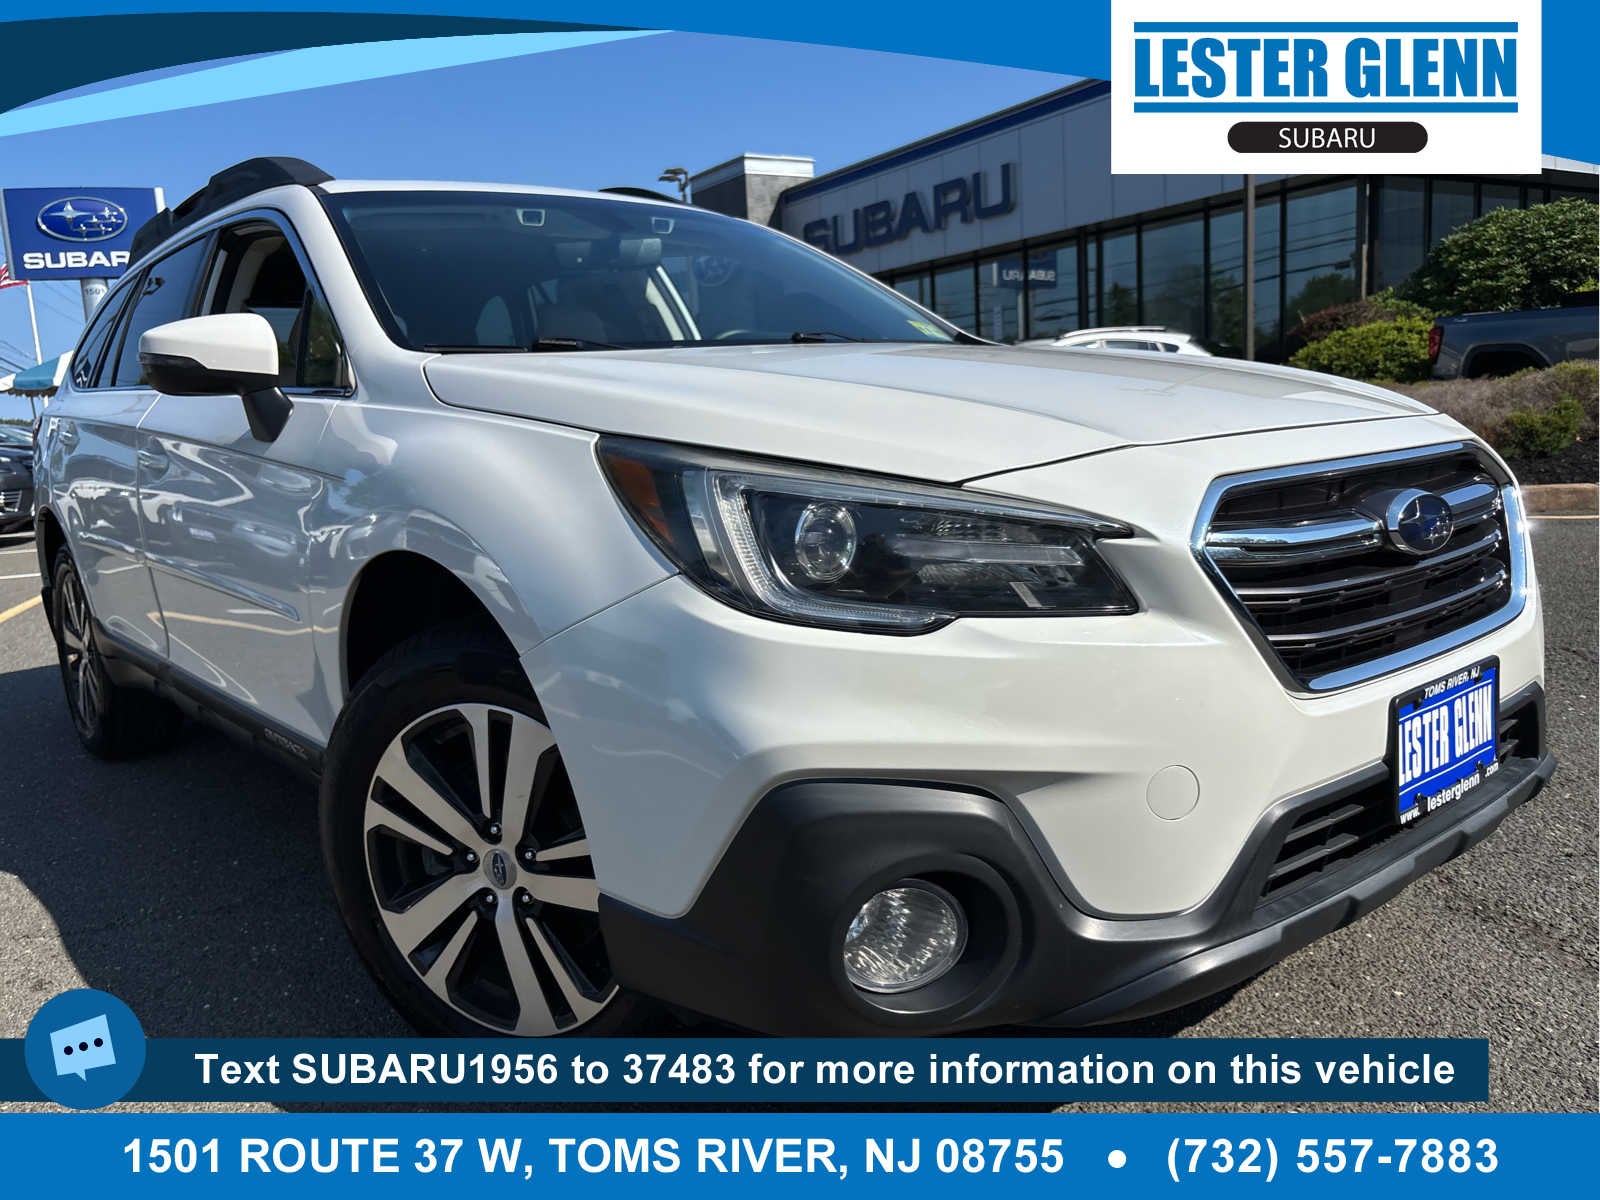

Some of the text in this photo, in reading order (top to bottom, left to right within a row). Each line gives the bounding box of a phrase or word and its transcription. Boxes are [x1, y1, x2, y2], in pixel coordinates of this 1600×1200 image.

[803, 162, 1014, 255] SUBARU
[23, 250, 131, 270] SUBAR
[1424, 680, 1447, 700] TOMS
[1470, 665, 1480, 681] NJ
[1399, 684, 1493, 787] LESTER GLENN
